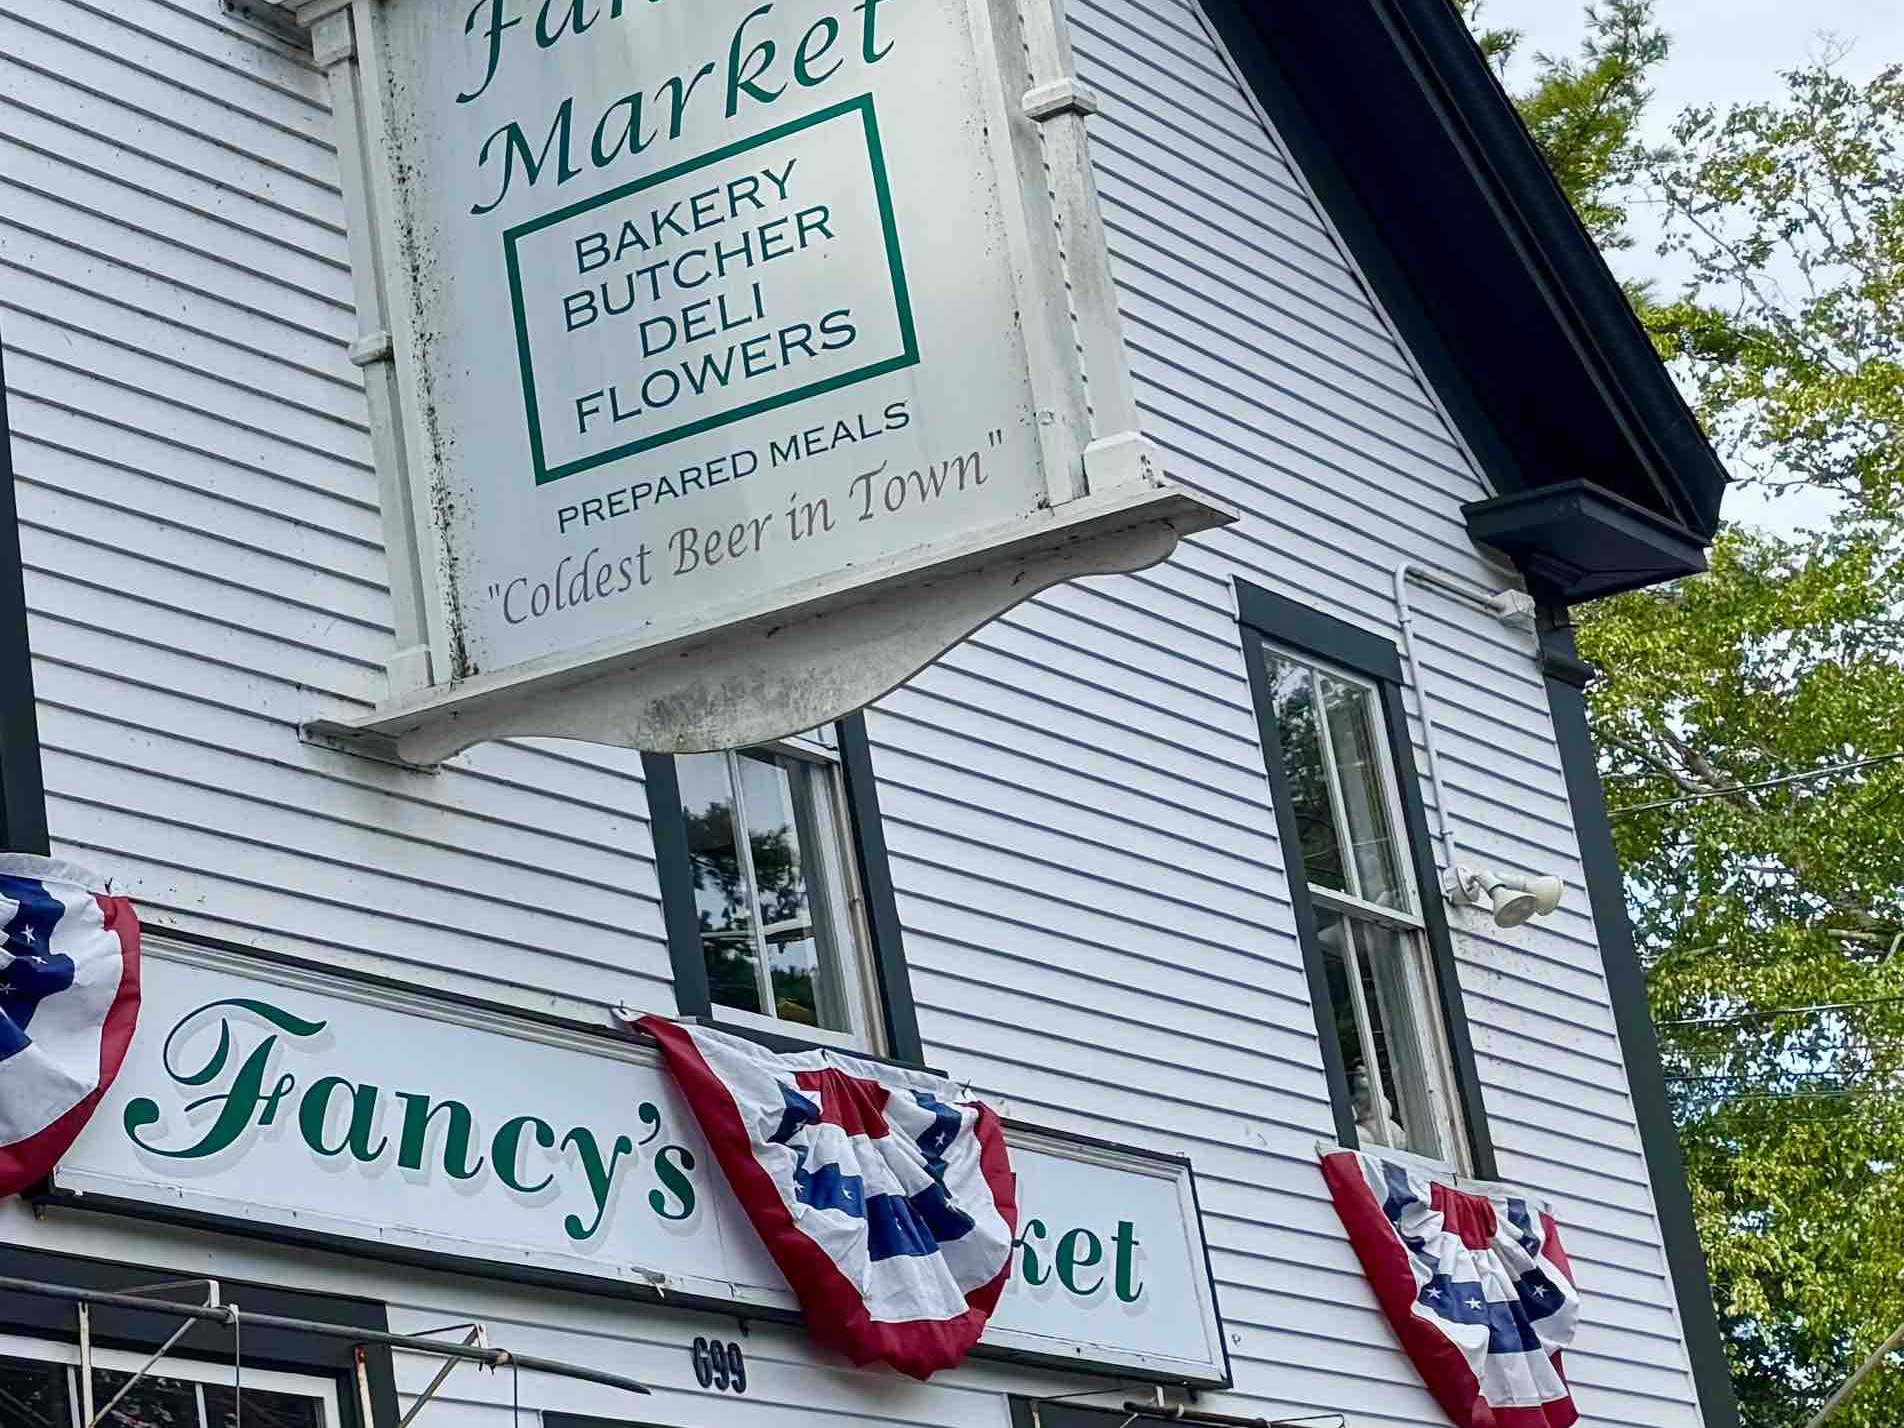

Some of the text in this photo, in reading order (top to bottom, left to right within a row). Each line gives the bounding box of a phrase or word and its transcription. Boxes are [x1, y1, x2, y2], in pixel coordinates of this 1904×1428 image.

[563, 204, 835, 332] BUTCHER
[574, 158, 797, 273] BAKERY
[574, 308, 857, 433] FLOWERS
[639, 282, 767, 358] DELI
[557, 402, 911, 535] PREPARED MEALS
[668, 514, 774, 576] Beer
[785, 491, 836, 541] in
[123, 997, 696, 1241] Fancy's
[691, 1336, 746, 1394] 699
